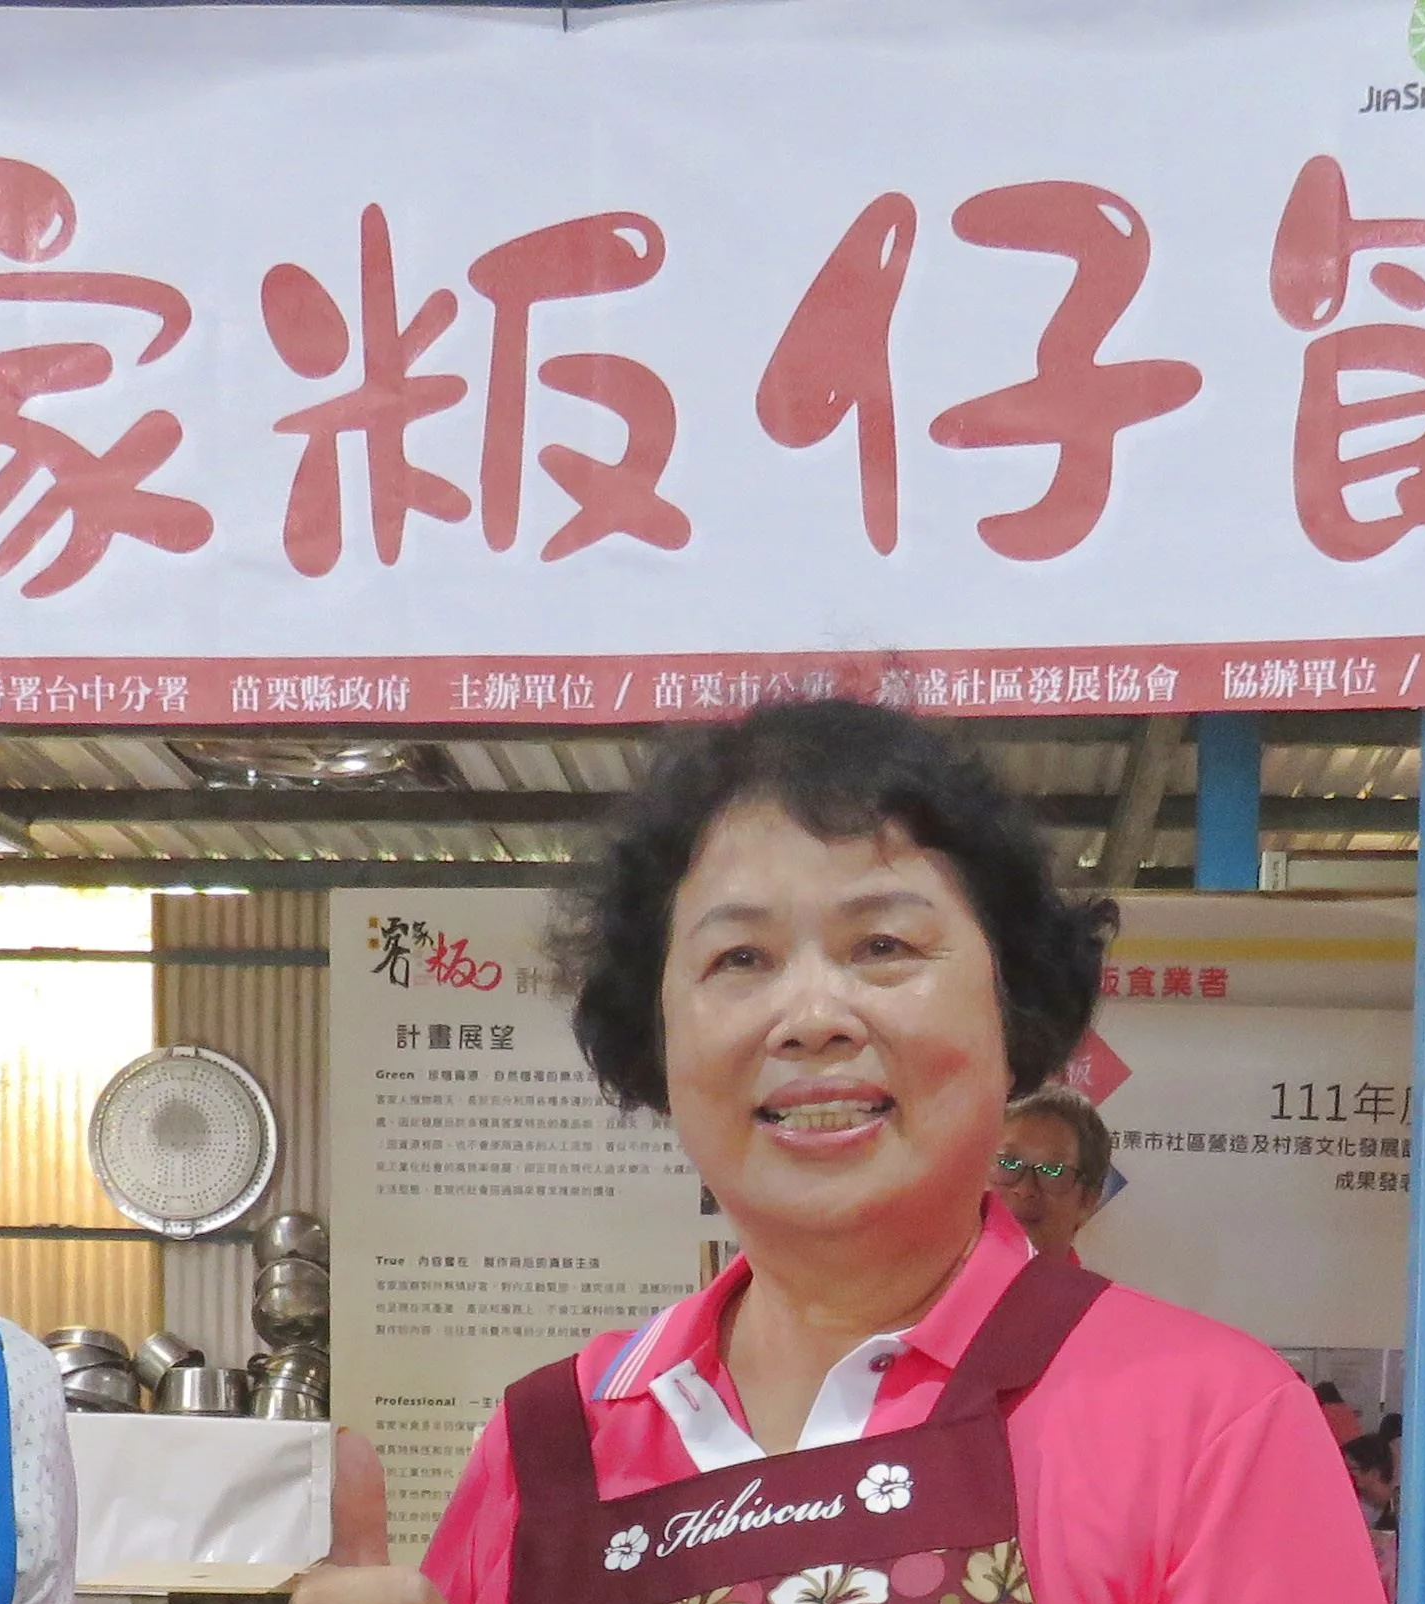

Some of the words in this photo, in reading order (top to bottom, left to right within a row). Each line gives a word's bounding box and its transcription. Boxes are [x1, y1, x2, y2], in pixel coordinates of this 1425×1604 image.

[230, 673, 411, 713] 苗栗縣政府
[450, 672, 595, 711] 主辦單位
[1221, 659, 1376, 698] 協辦單位
[396, 1024, 515, 1050] 計畫展望
[375, 1070, 415, 1080] Green
[1271, 1082, 1412, 1125] 111年
[375, 1256, 405, 1266] True
[375, 1396, 456, 1407] Professional
[657, 1478, 846, 1557] Hibiscus
